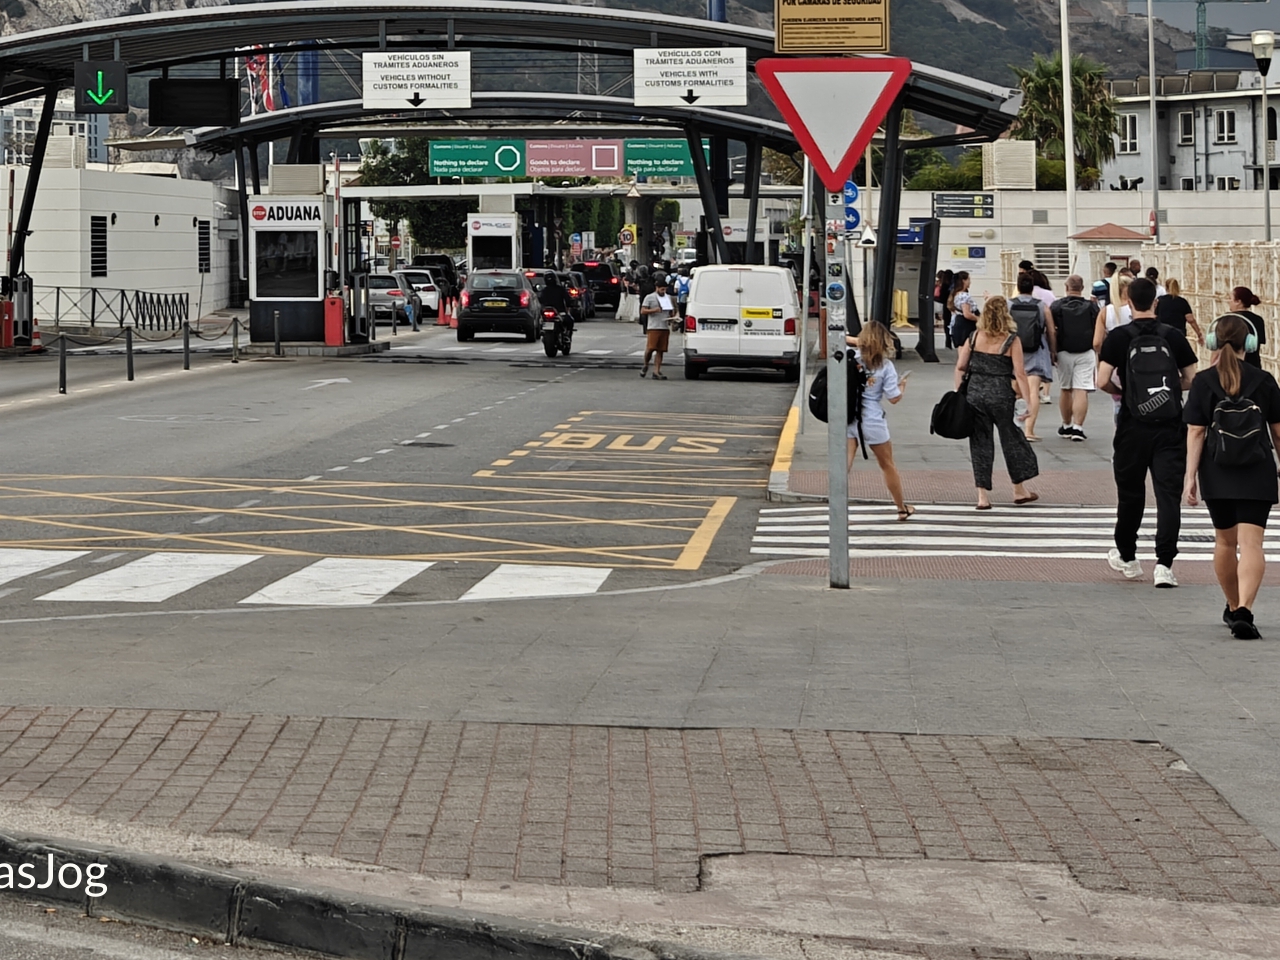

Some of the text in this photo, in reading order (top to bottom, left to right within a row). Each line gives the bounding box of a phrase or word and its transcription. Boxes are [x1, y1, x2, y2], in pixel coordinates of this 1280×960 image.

[433, 159, 458, 167] Nothing
[267, 206, 322, 221] ADUANA
[623, 233, 631, 242] 10
[1137, 390, 1170, 416] PUMA
[543, 432, 726, 453] BUS
